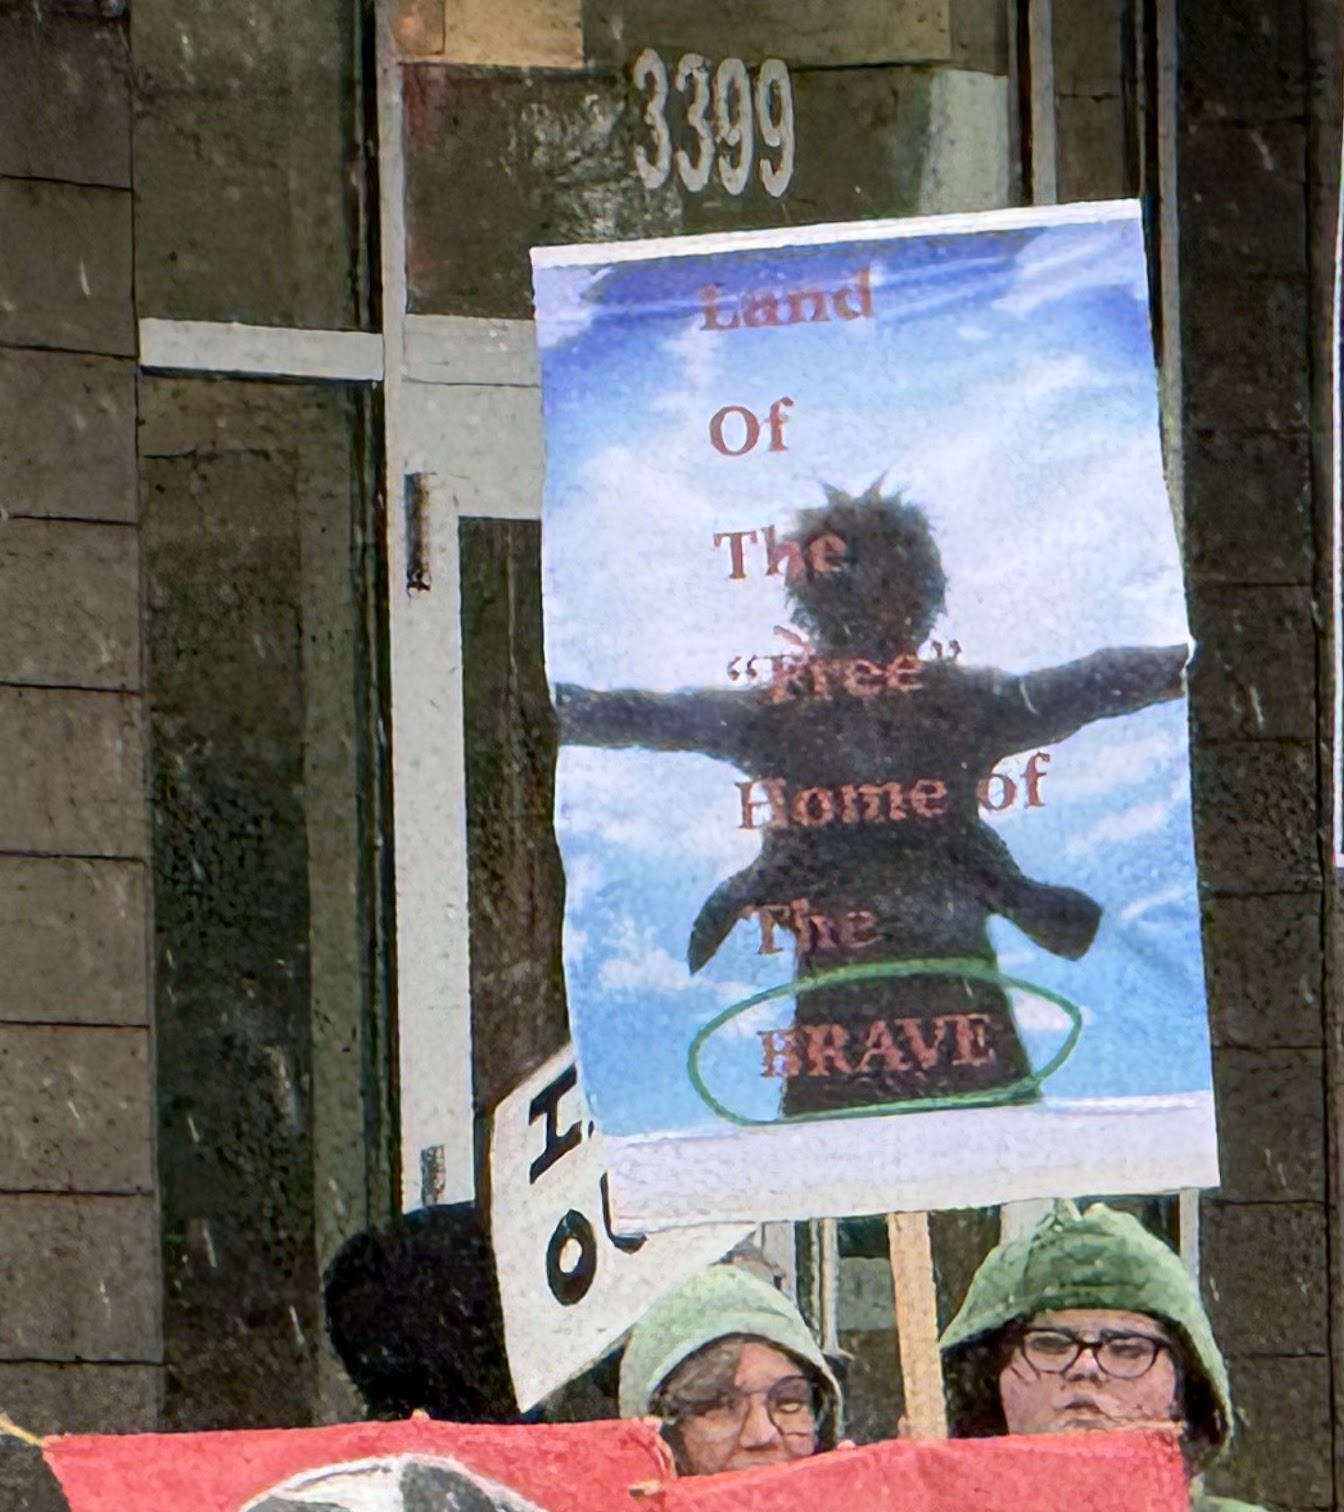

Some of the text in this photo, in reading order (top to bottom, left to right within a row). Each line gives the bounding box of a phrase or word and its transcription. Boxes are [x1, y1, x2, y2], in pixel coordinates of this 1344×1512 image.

[633, 48, 795, 197] 3399
[701, 268, 874, 331] Land
[708, 396, 794, 456] Of
[713, 523, 850, 580] The
[735, 752, 1052, 830] Home of
[744, 898, 880, 956] The
[759, 1012, 997, 1079] BRAVE
